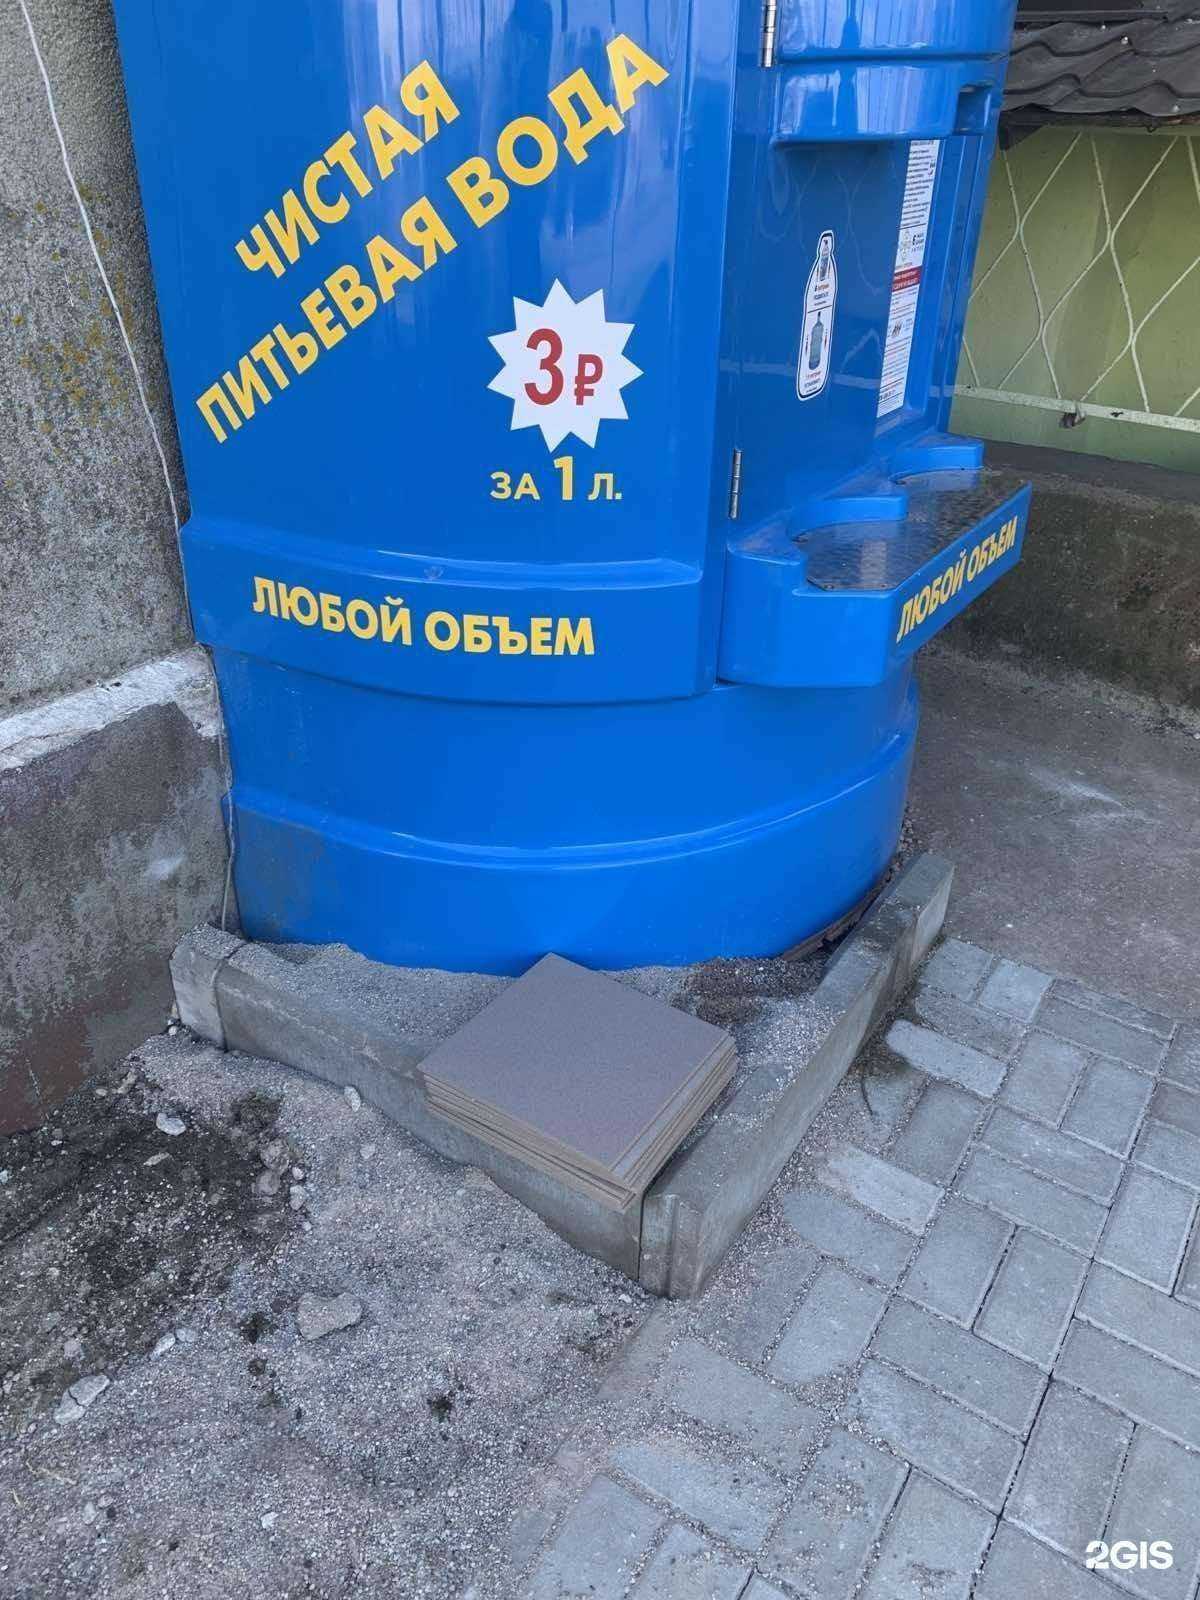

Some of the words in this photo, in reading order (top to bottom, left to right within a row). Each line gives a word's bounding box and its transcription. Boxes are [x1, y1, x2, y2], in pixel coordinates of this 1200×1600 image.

[235, 59, 460, 278] ЧИСТАЯ
[196, 196, 458, 443] ПИТЬЕВАЯ
[446, 34, 669, 228] ВОДА
[524, 327, 565, 406] 3
[490, 471, 541, 500] ЗА
[553, 455, 574, 501] 1
[252, 577, 412, 647] ЛЮБОЙ
[423, 610, 595, 656] ОБЪЕМ
[896, 548, 967, 644] ЛЮБОЙ
[966, 515, 1018, 582] ОБЪЕМ
